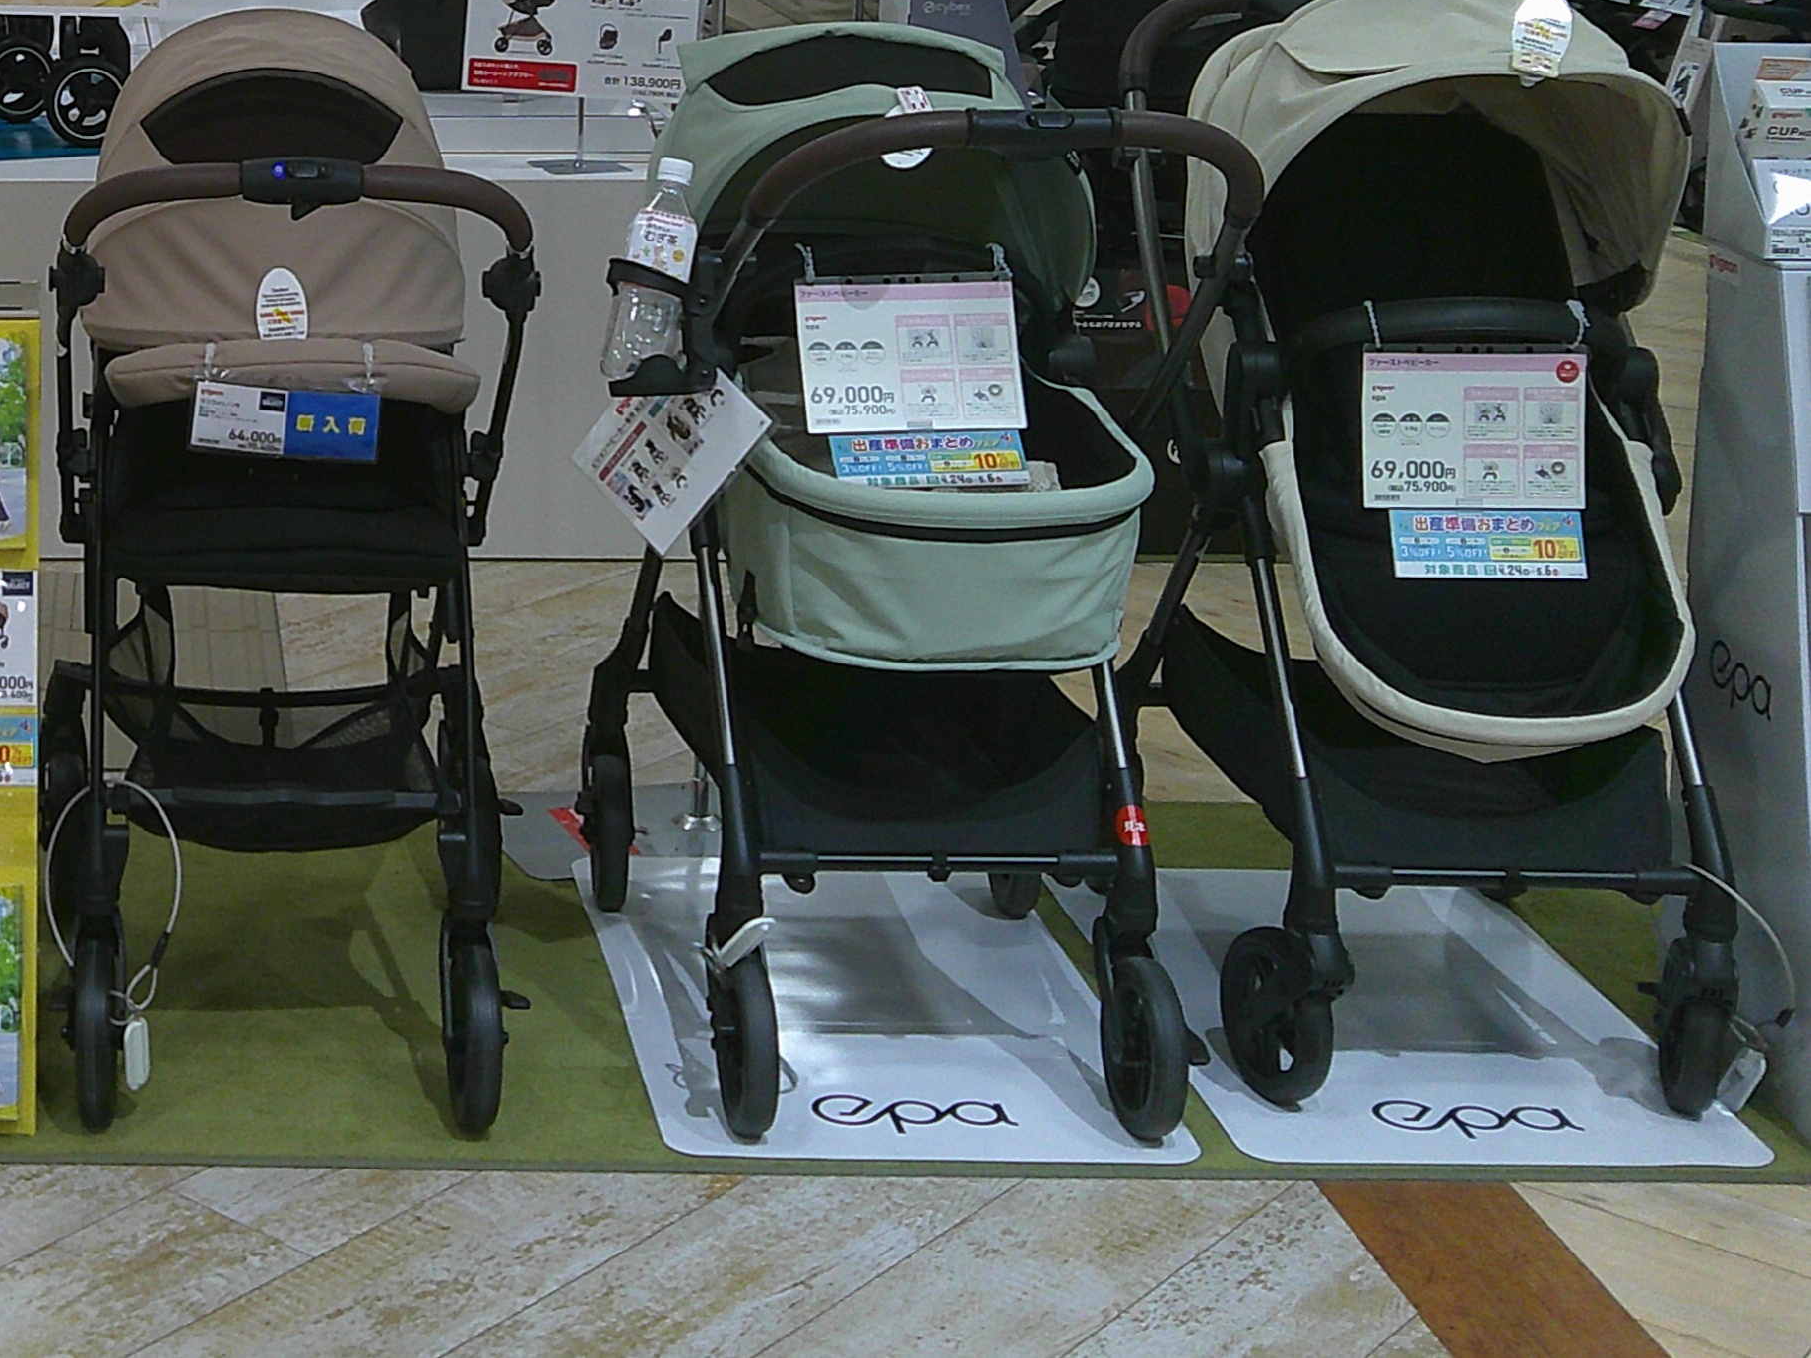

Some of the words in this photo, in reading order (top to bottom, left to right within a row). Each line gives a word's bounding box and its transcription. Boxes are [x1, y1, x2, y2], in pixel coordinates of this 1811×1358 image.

[643, 229, 679, 247] むぎ茶
[810, 385, 895, 405] 69,000円
[973, 453, 997, 470] 10
[1371, 460, 1456, 480] 69,000円
[1534, 540, 1556, 559] 10
[1709, 640, 1772, 722] epa
[811, 1093, 1020, 1136] epa
[1370, 1099, 1586, 1141] epa
